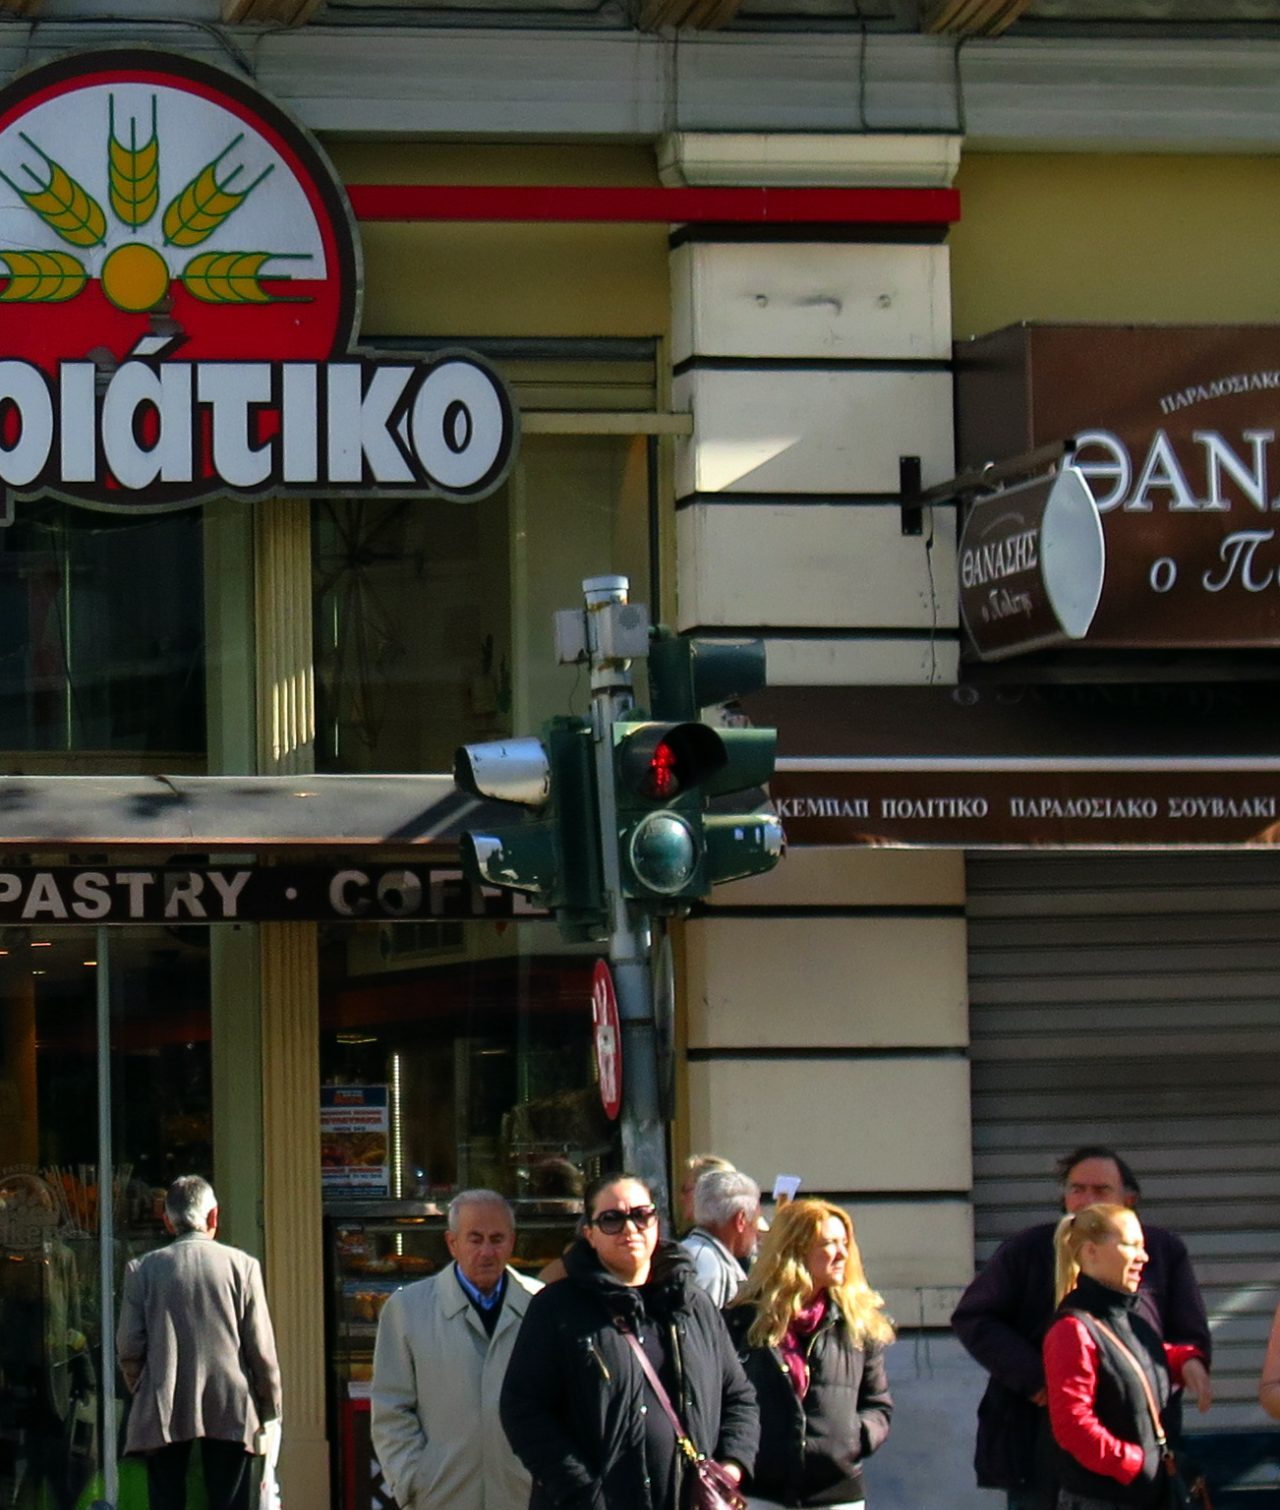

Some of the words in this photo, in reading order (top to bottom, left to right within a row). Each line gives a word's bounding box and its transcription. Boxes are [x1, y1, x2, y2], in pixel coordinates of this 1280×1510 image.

[1068, 430, 1280, 513] ΘΑΝ
[962, 529, 1038, 588] ΘΑΝΑΣΗΣ
[1202, 529, 1280, 593] Π
[776, 798, 869, 818] ΚΕΜΠΑΠ
[882, 798, 989, 818] ΠΟΛΙΤΙΚΟ
[1010, 798, 1158, 818] ΠΑΡΑΔΟΣΙΑΚΟ
[1168, 797, 1276, 818] ΣΟΥΒΛΑΚΙ
[329, 869, 550, 915] COFF
